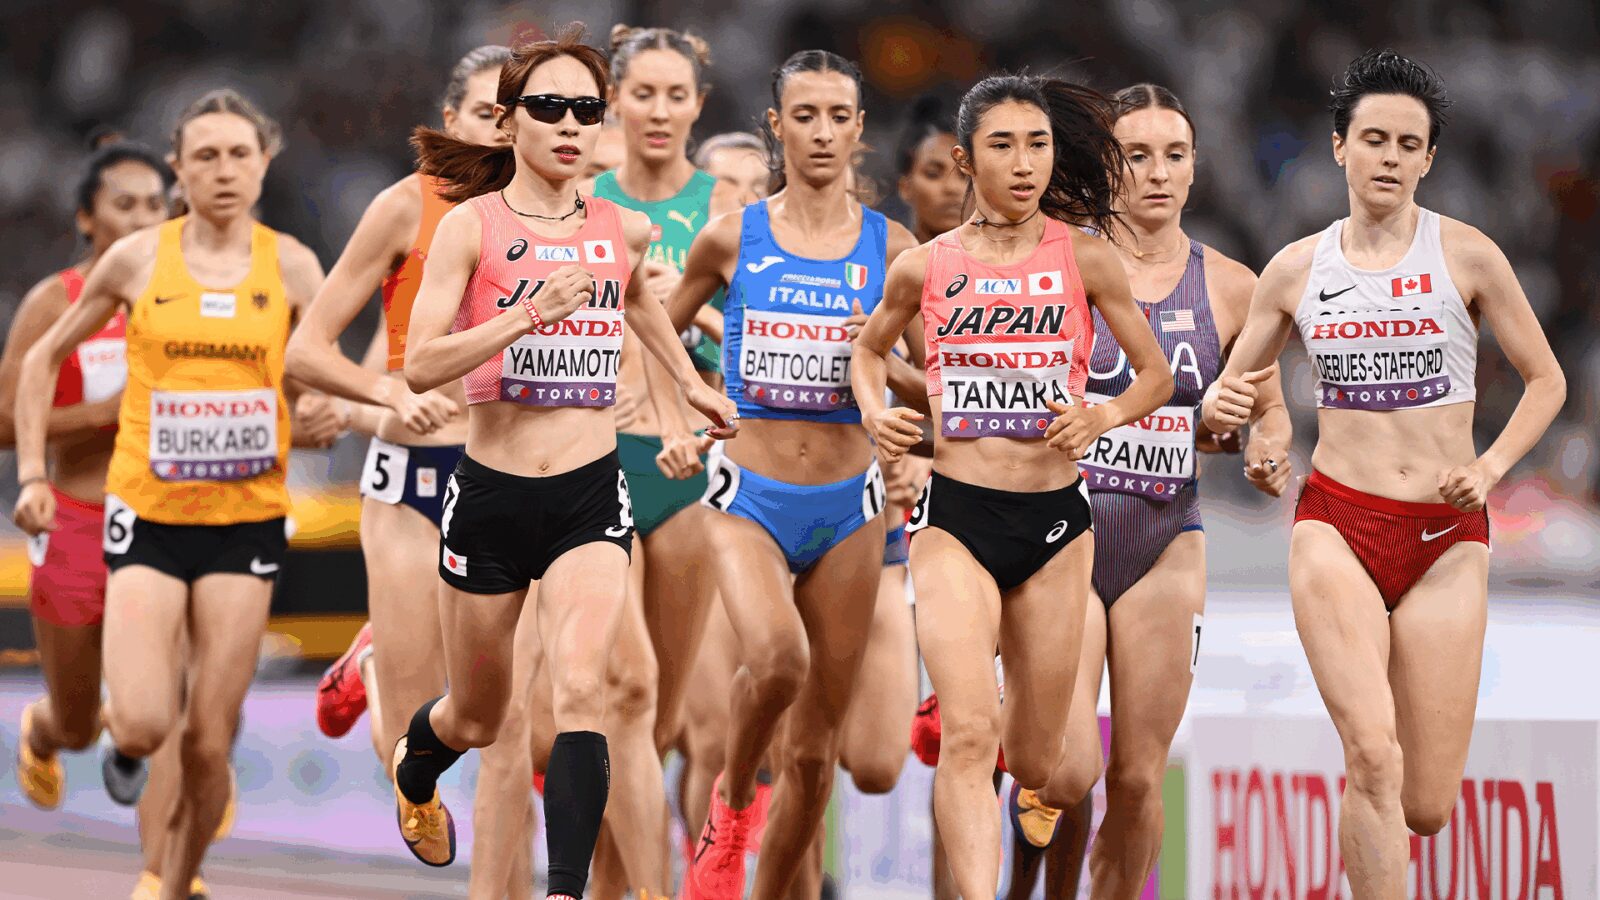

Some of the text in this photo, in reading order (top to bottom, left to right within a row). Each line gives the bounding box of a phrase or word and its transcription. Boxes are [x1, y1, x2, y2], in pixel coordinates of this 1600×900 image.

[538, 247, 576, 260] ACN
[768, 286, 849, 311] ITALIA
[977, 280, 1019, 293] ACN
[527, 319, 622, 336] ONDA
[746, 319, 852, 342] HOND
[937, 304, 1066, 337] JAPAN
[1311, 318, 1444, 339] HONDA
[164, 340, 268, 362] GERMANY
[941, 351, 1069, 369] HONDA
[1088, 333, 1203, 390] UA
[1316, 348, 1443, 382] DEBUES-STAFFORD
[155, 400, 271, 417] HONDA
[948, 380, 1069, 409] TANAKA
[1081, 401, 1191, 432] NDA
[158, 426, 270, 454] BURKARD
[1081, 436, 1188, 475] RANNY
[372, 452, 390, 491] 5
[109, 508, 127, 543] 6
[1211, 768, 1346, 900] HOND
